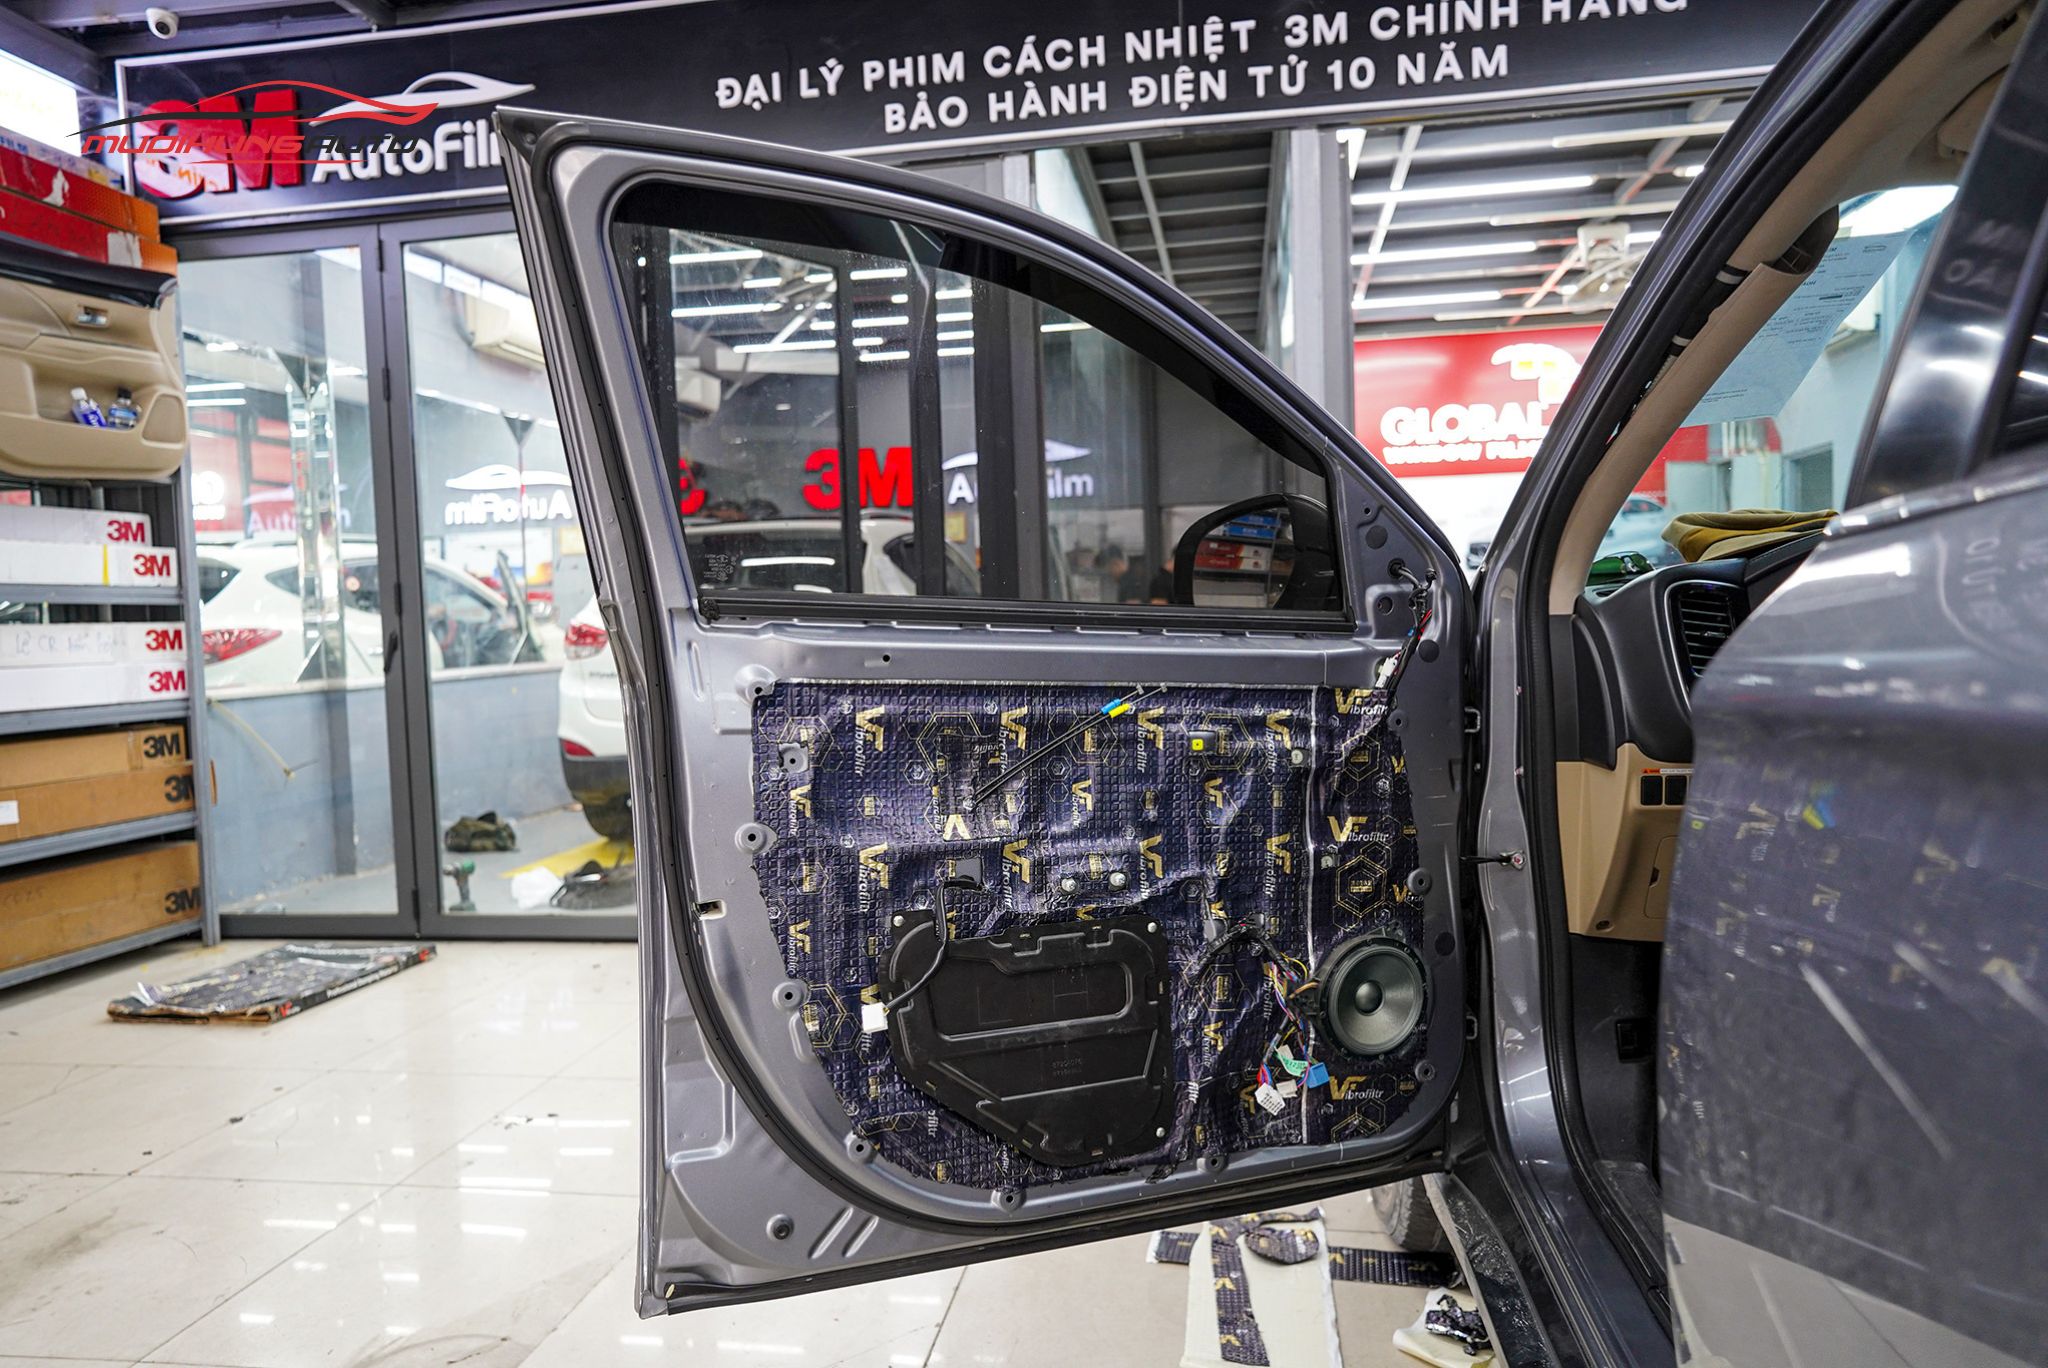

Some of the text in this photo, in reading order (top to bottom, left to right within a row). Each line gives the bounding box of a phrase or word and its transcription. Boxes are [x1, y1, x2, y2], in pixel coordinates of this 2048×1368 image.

[715, 71, 782, 111] ĐẠI
[800, 58, 845, 99] LÝ
[863, 50, 965, 92] PHIM
[983, 35, 1106, 79] CÁCH
[1124, 16, 1257, 63] NHIỆT
[1284, 10, 1349, 48] 3M
[884, 41, 1509, 134] BẢO HÀNH ĐIỆN TỬ 10 NĂM
[803, 447, 914, 511] 3M
[106, 519, 146, 543] 3M
[133, 553, 171, 577] 3M
[145, 629, 183, 651] 3M
[149, 669, 186, 693] 3M
[142, 733, 181, 758] 3M
